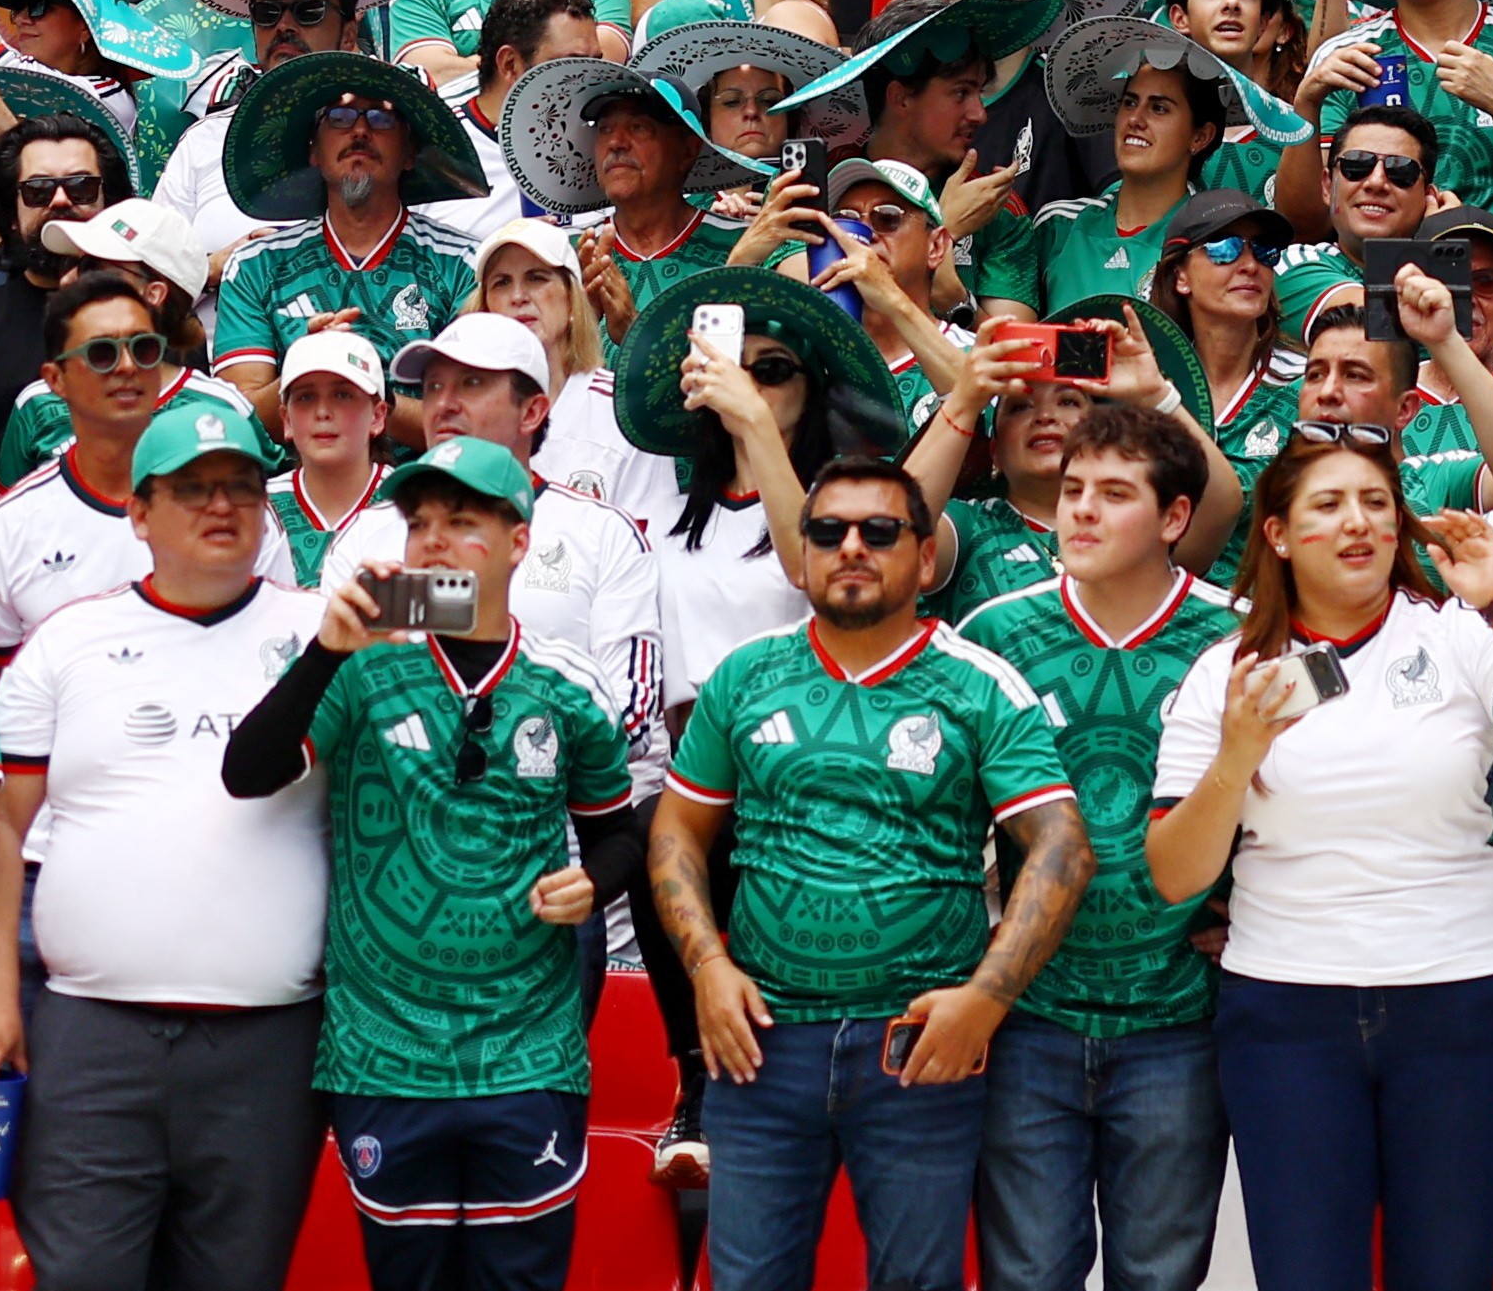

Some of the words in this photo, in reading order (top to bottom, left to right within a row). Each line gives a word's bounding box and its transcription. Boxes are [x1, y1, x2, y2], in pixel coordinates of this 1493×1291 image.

[512, 79, 530, 102] FIFA
[503, 141, 514, 164] FIFA
[534, 193, 554, 210] FIFA
[1170, 330, 1191, 359] FIFA
